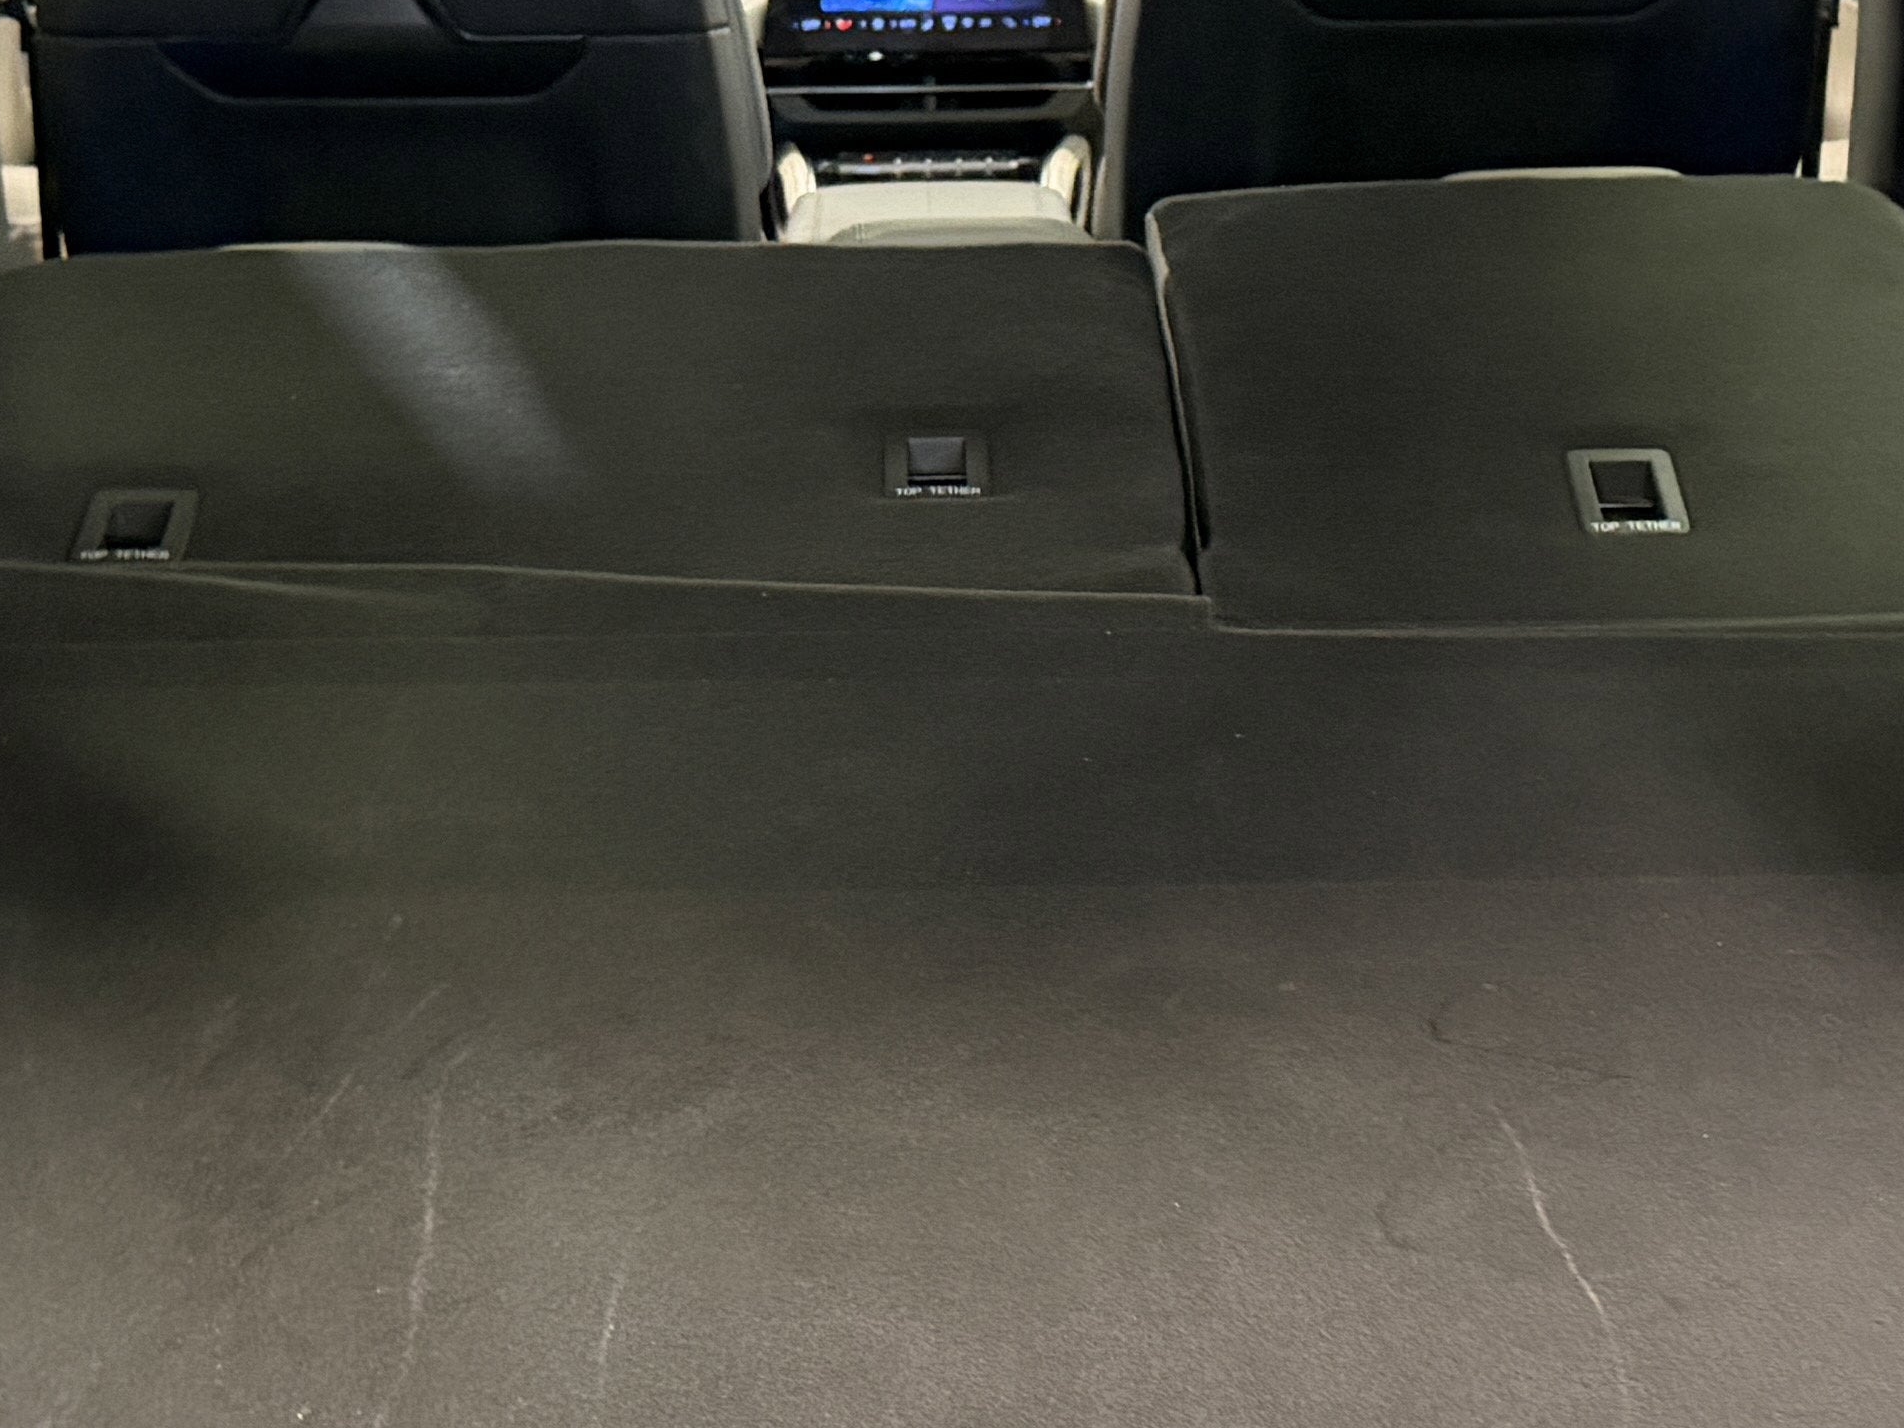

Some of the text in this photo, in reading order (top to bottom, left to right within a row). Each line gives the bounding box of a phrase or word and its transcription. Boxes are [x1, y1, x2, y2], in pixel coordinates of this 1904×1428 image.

[895, 486, 923, 496] TOP
[1590, 520, 1682, 532] TOP TETHER
